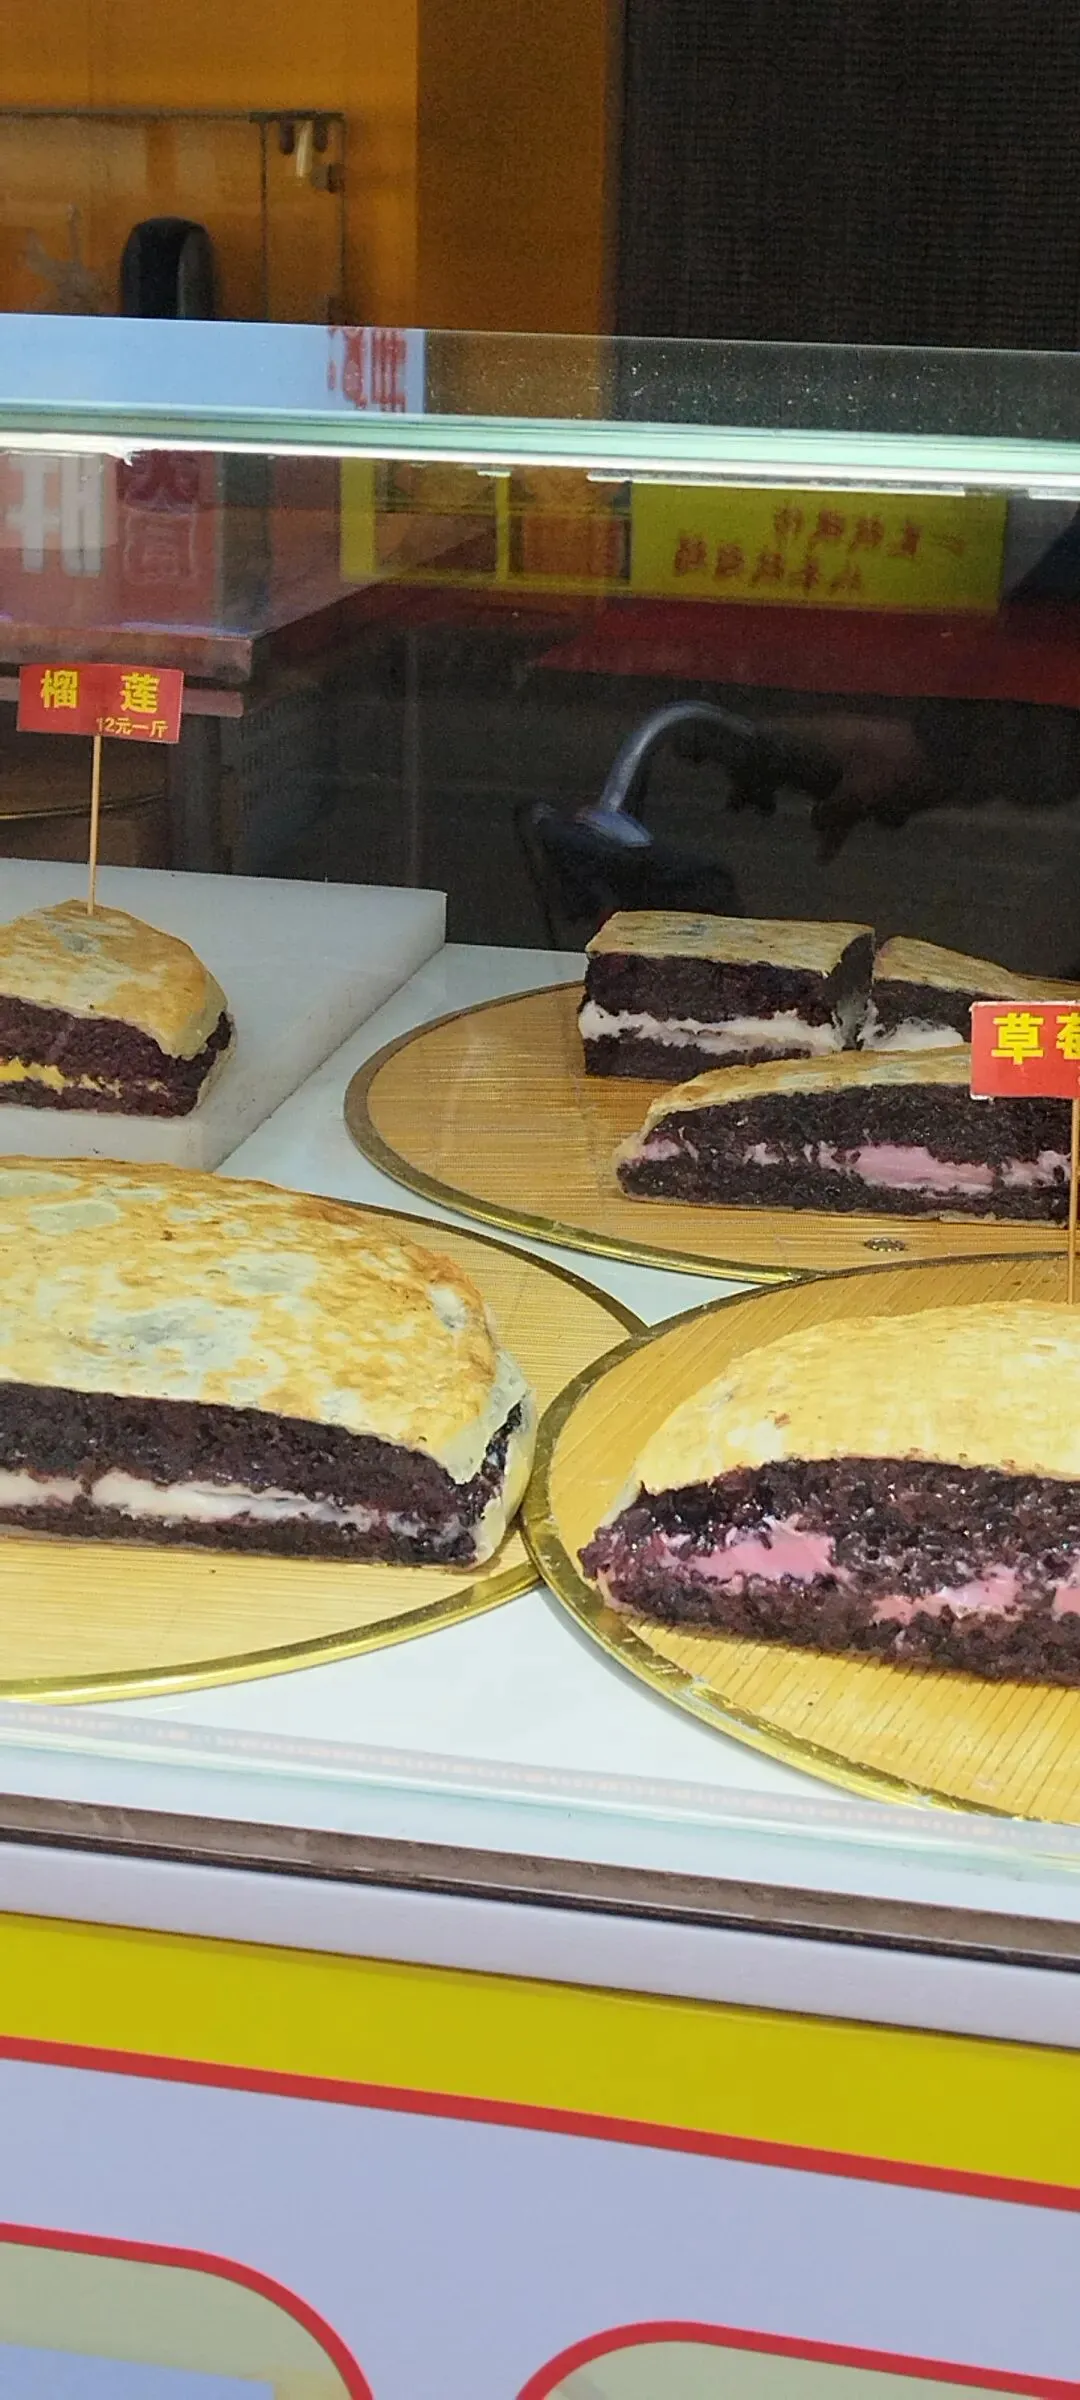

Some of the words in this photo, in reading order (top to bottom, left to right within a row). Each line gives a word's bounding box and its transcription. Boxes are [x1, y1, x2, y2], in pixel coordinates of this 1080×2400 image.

[40, 669, 161, 714] 榴莲
[96, 717, 168, 738] 12元一斤
